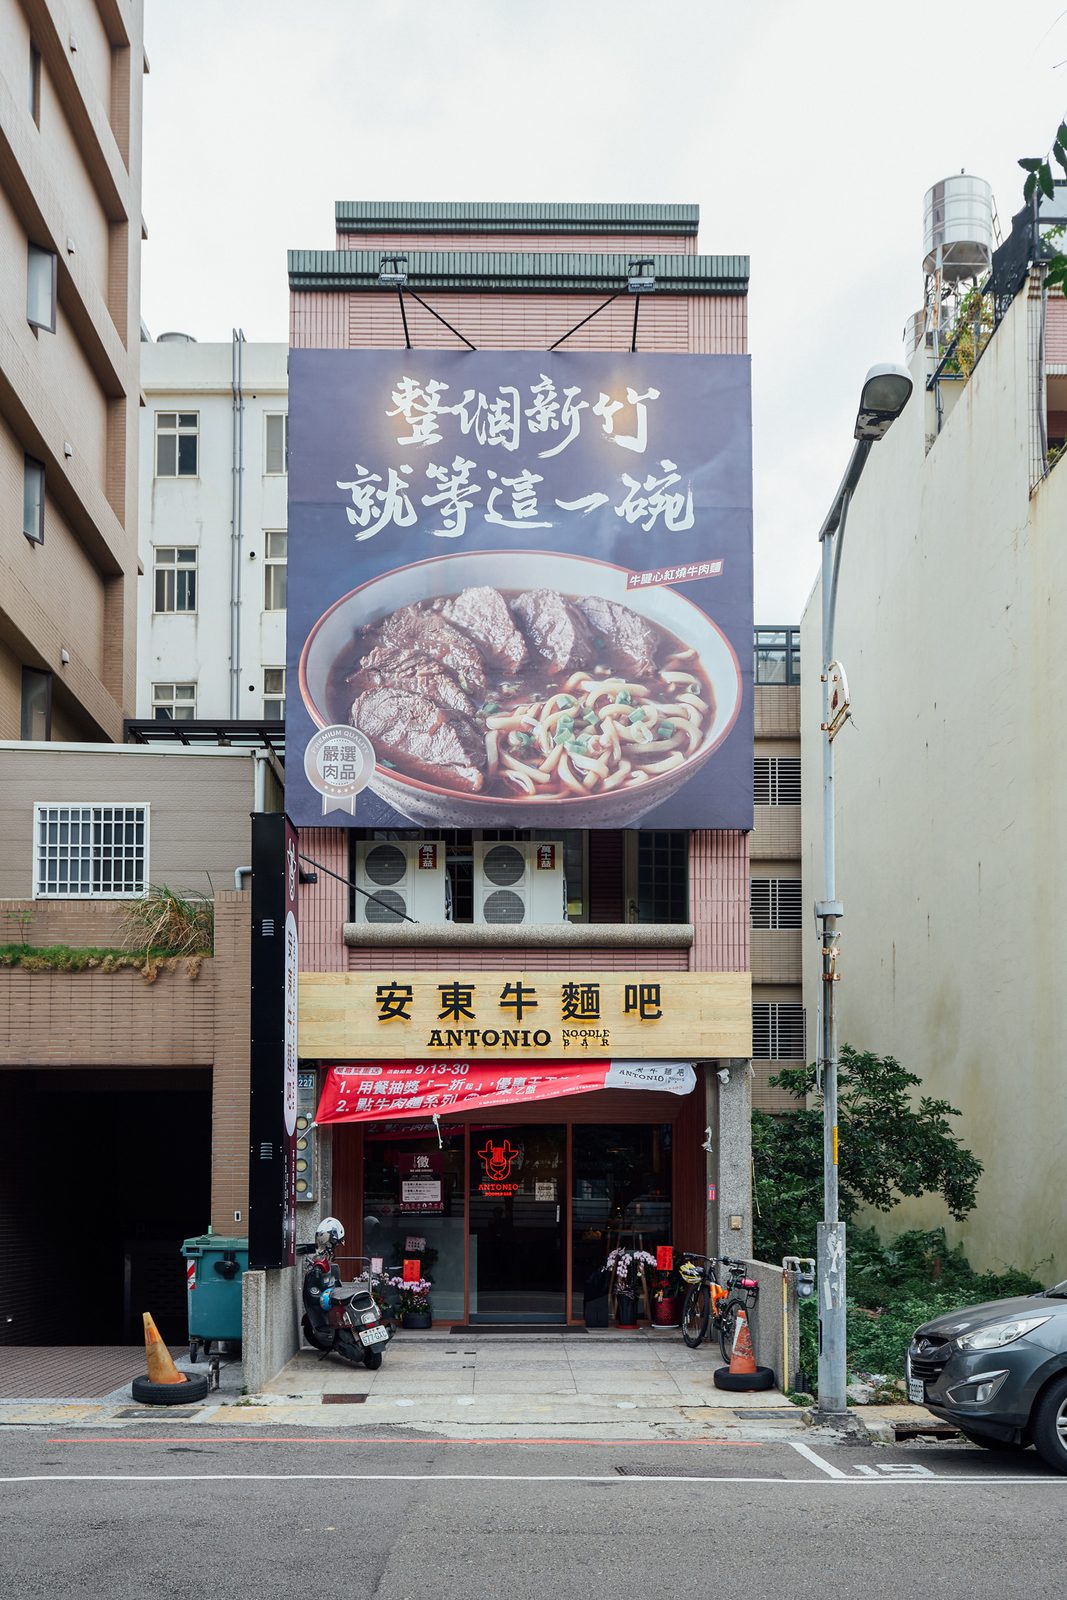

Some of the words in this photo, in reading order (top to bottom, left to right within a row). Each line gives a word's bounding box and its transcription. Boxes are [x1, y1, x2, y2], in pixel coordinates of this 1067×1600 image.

[385, 373, 660, 458] 整個新竹
[336, 455, 695, 541] 就等這一碗
[310, 730, 342, 753] PREMIUM
[343, 730, 369, 753] QUALITY
[323, 745, 356, 762] 嚴選
[323, 764, 356, 780] 肉品
[375, 981, 662, 1021] 安東牛麵吧
[427, 1029, 551, 1047] ANTONIO
[562, 1029, 610, 1038] NOODLE
[415, 1063, 469, 1075] 9/13-30
[619, 1069, 665, 1082] ANTONIO
[298, 1079, 312, 1087] 227
[339, 1081, 350, 1094] 1.
[336, 1100, 349, 1112] 2.
[478, 1183, 519, 1191] ANTONIO
